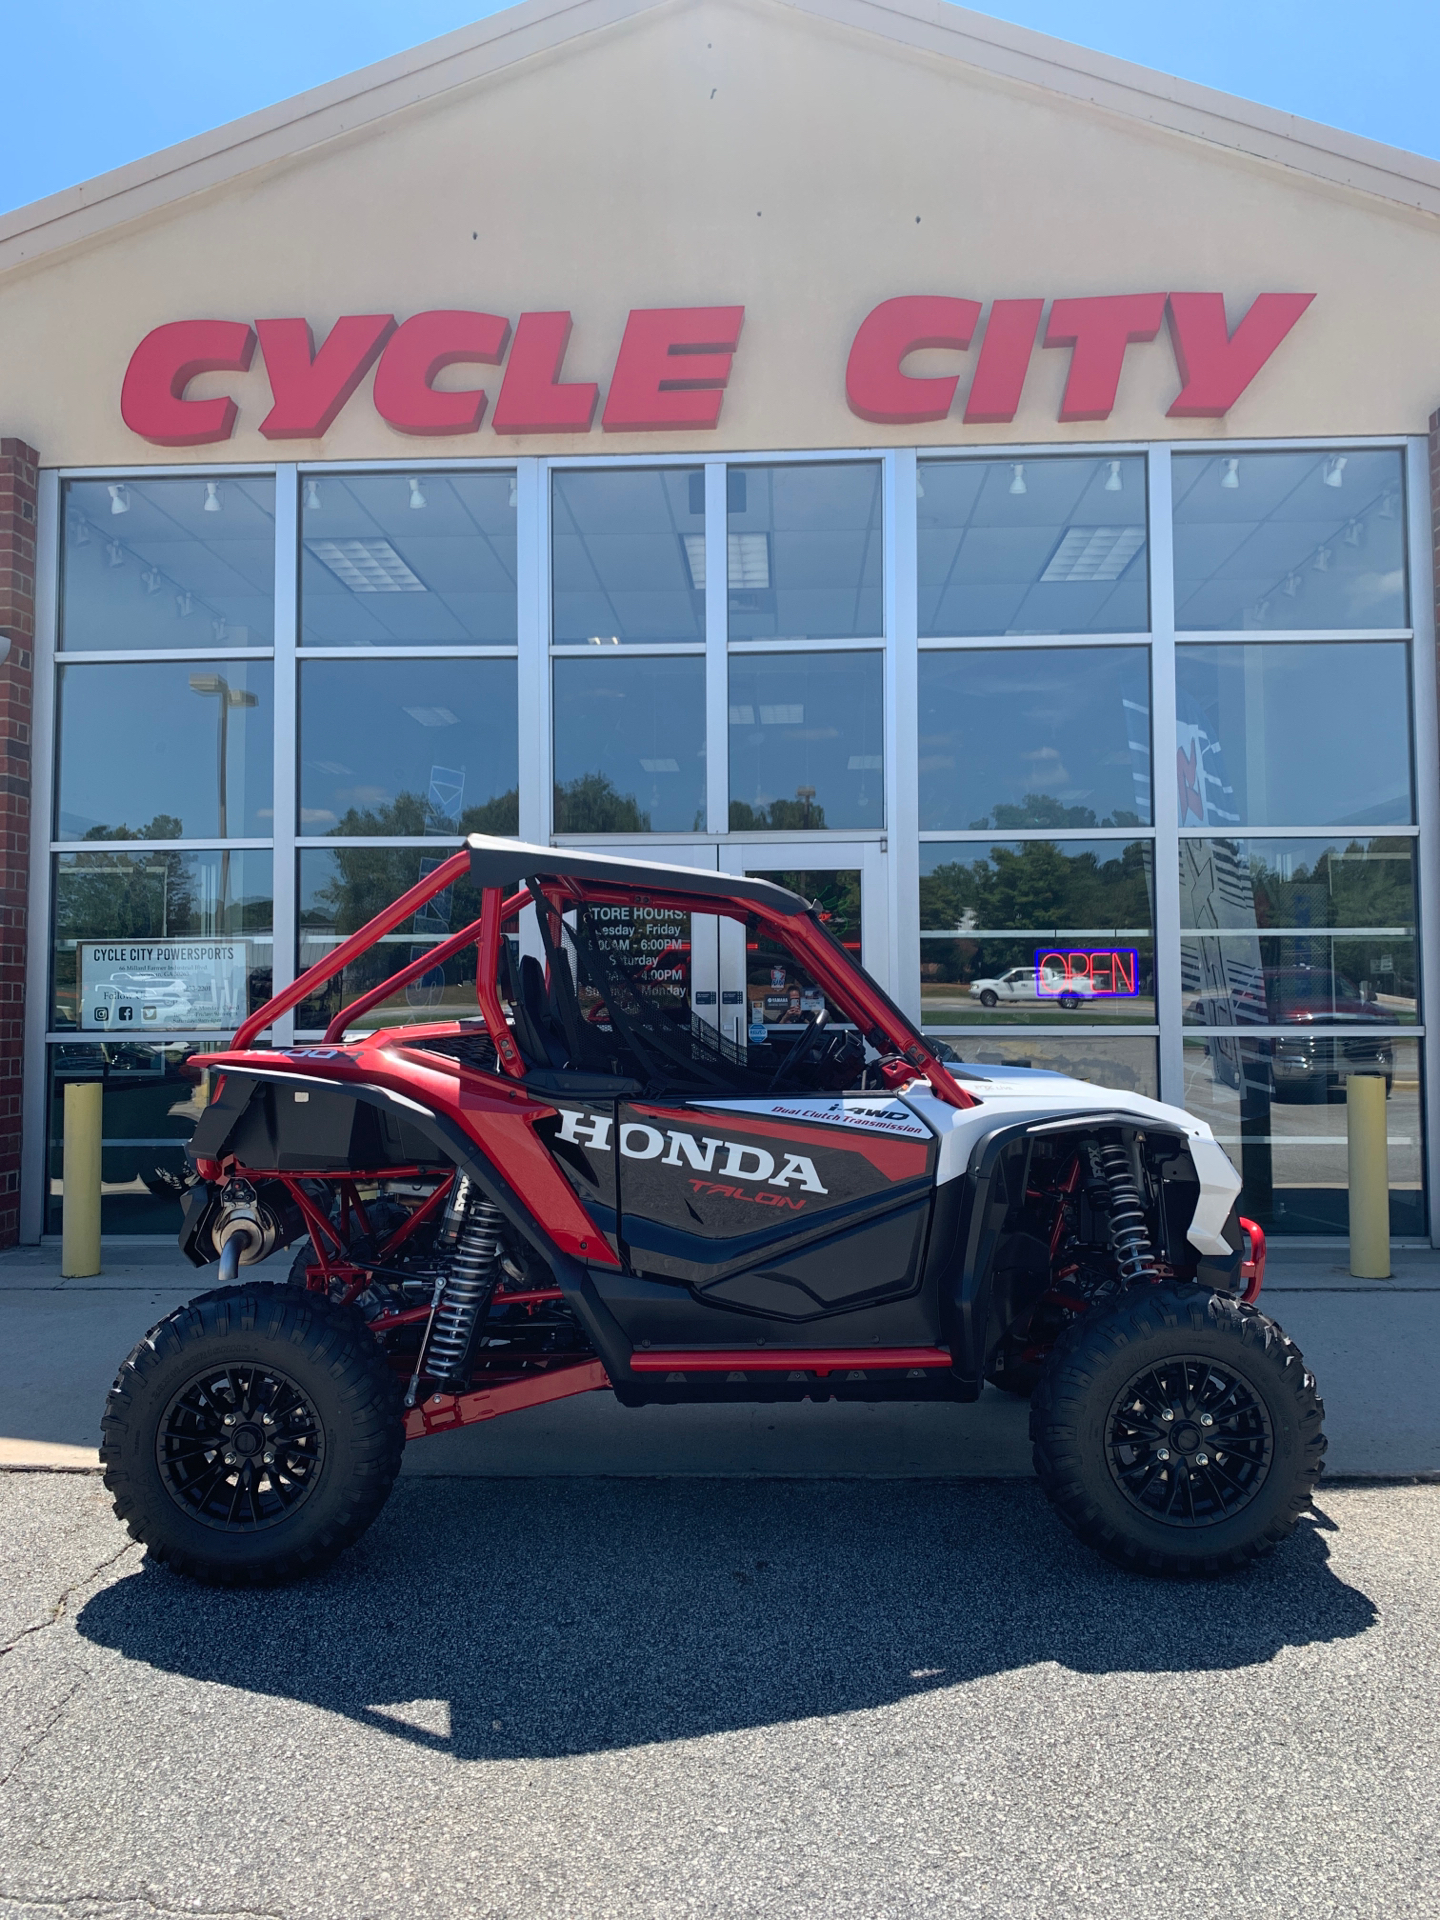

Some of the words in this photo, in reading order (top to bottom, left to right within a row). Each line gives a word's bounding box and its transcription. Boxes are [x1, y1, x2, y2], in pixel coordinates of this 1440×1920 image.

[121, 306, 745, 447] CYCLE
[845, 291, 1317, 424] CITY
[590, 907, 629, 920] TORE
[633, 906, 687, 919] HOURS:
[646, 924, 681, 936] Friday
[93, 948, 127, 962] CYCLE
[130, 948, 153, 961] CITY
[157, 947, 234, 961] POWERSPORTS
[640, 939, 683, 950] 6:00PM
[1041, 952, 1134, 993] OPEN
[641, 984, 686, 998] Monday
[771, 1106, 801, 1116] Dual
[802, 1109, 841, 1122] Clutch
[842, 1115, 923, 1135] Transmission
[828, 1103, 910, 1121] i-4WD
[554, 1108, 829, 1195] HONDA
[1087, 1146, 1106, 1178] FOX
[688, 1179, 807, 1210] TALON
